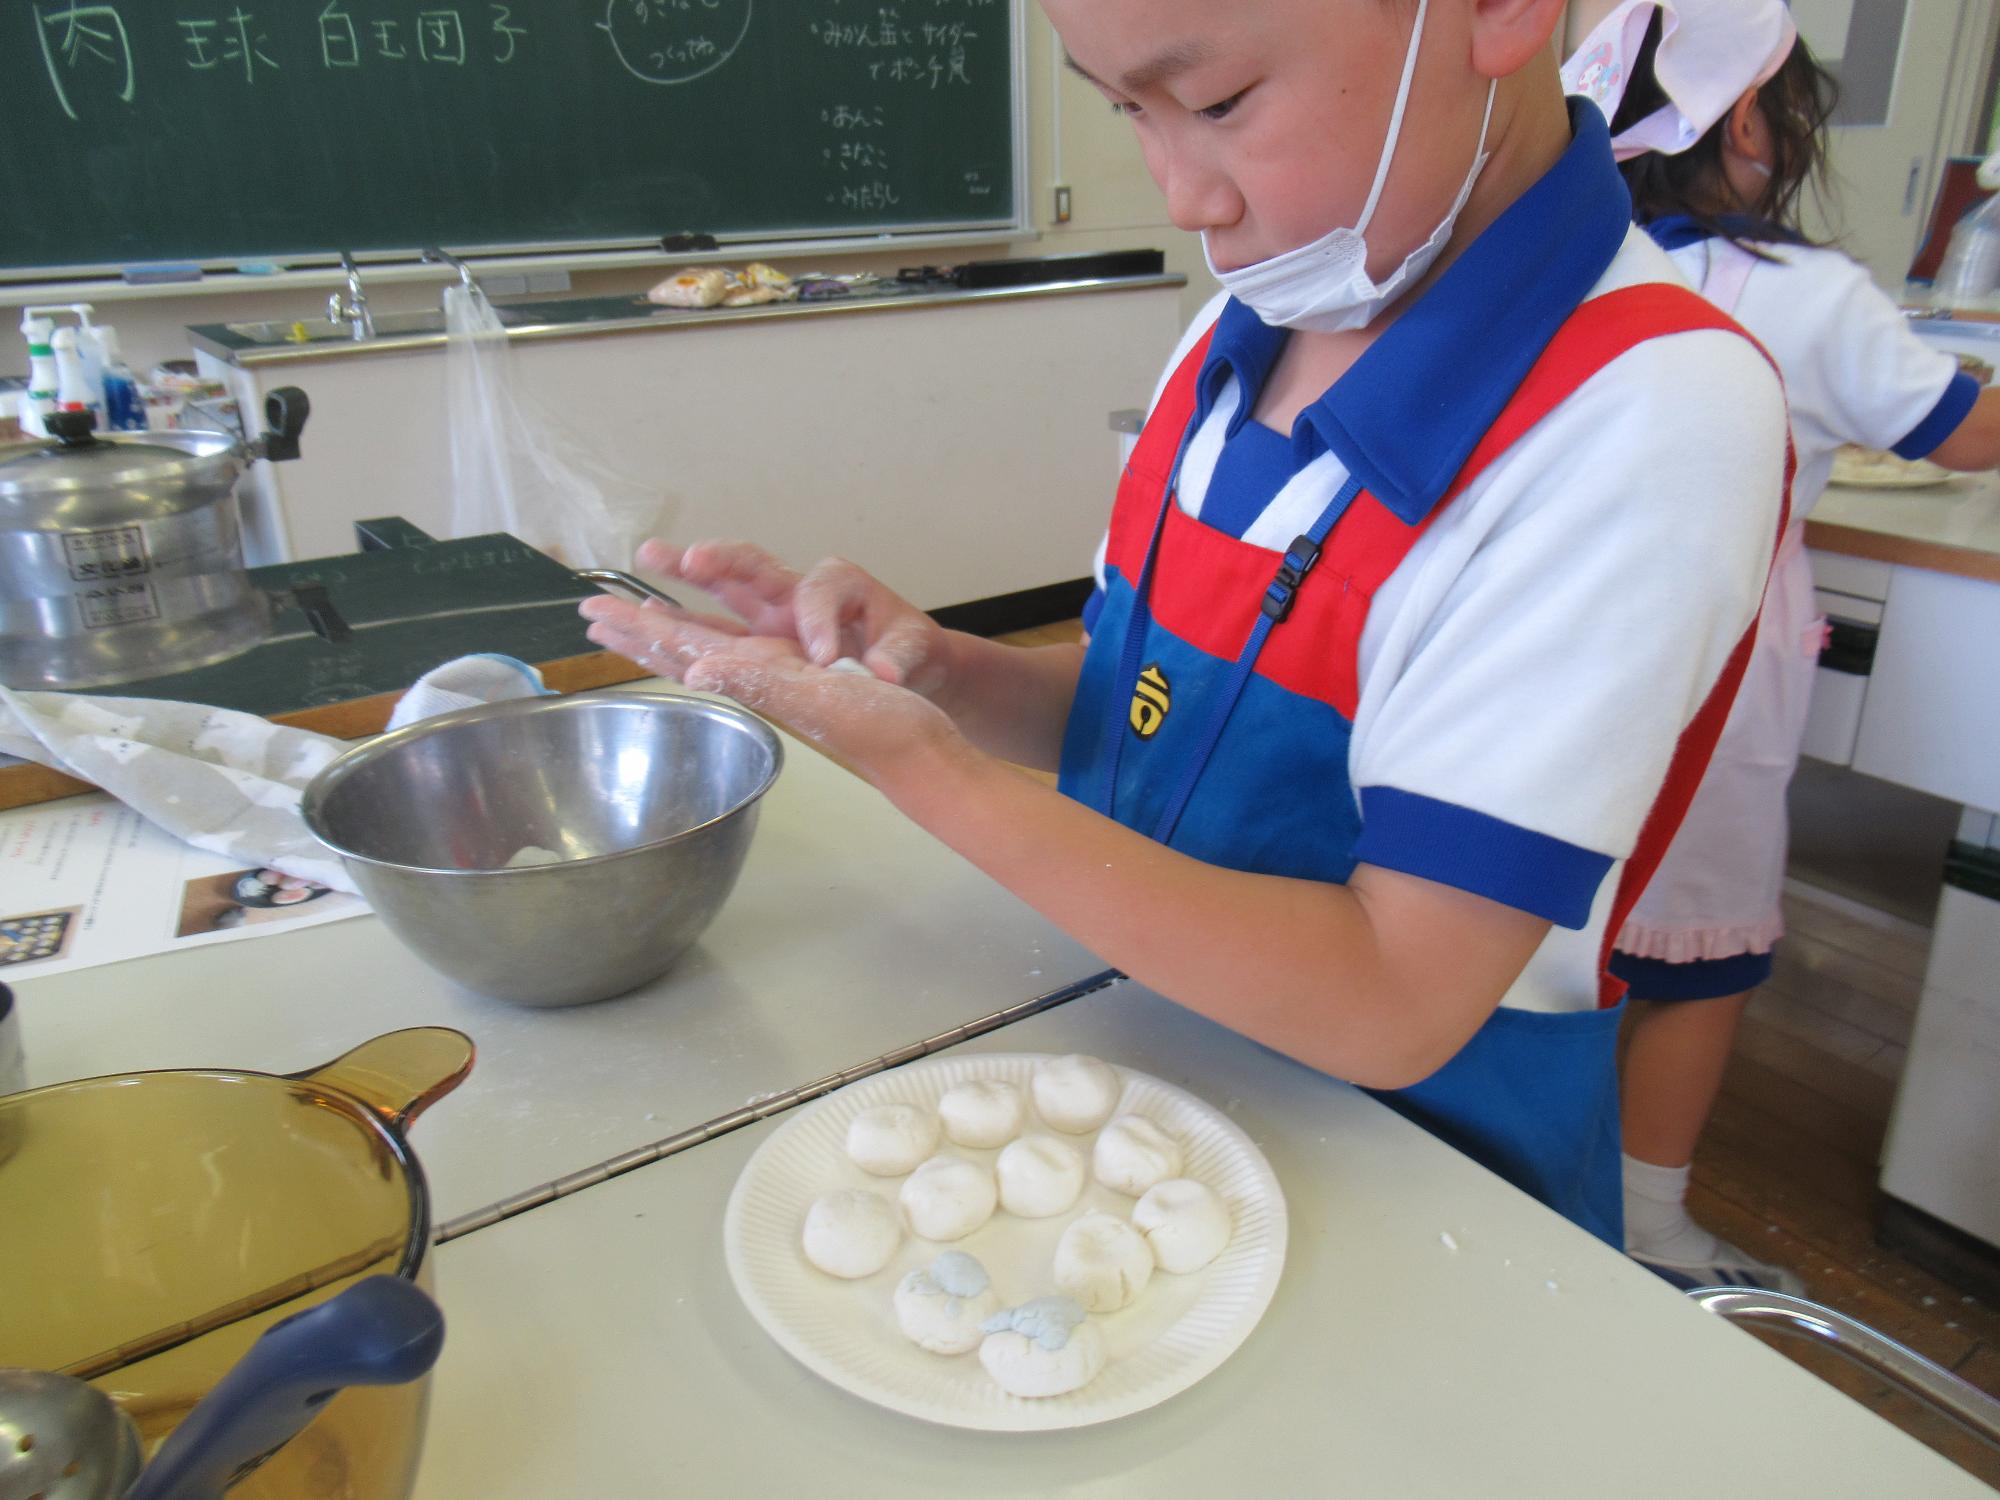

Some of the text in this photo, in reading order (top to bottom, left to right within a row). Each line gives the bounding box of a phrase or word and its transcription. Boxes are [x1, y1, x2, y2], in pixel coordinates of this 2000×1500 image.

[833, 105, 884, 129] あんこ
[840, 142, 888, 171] きなこ
[841, 181, 899, 209] みたらし
